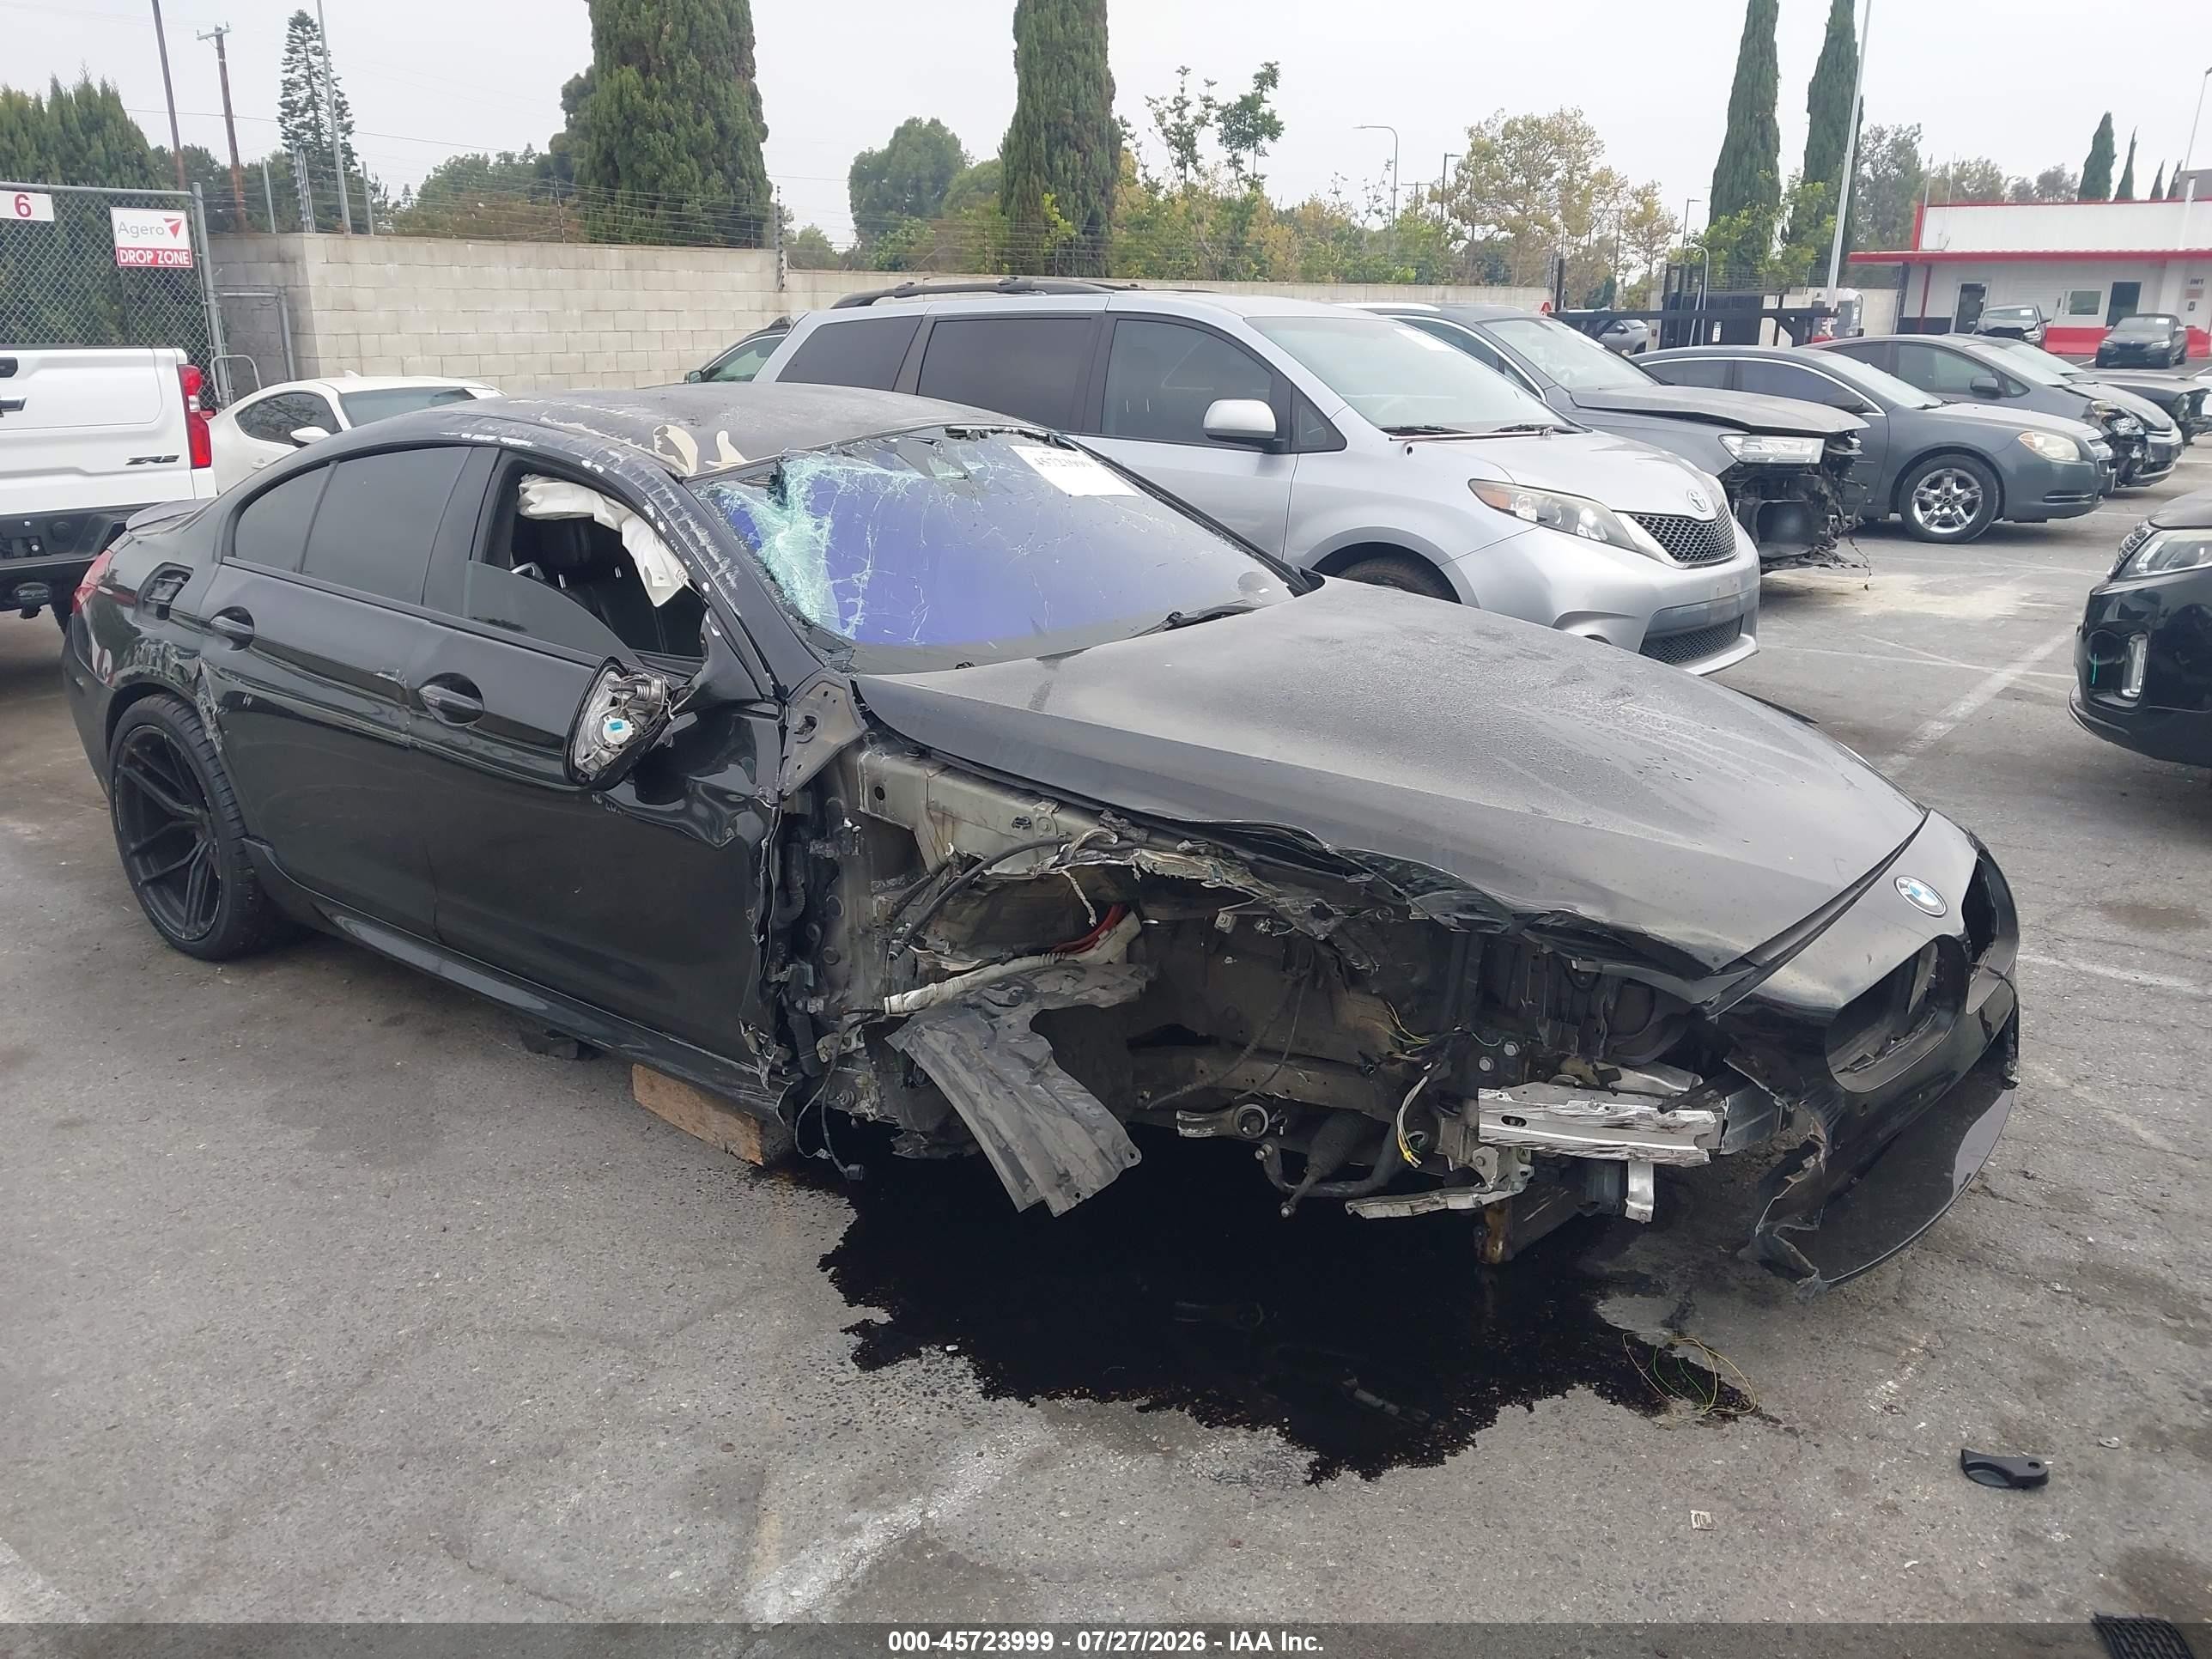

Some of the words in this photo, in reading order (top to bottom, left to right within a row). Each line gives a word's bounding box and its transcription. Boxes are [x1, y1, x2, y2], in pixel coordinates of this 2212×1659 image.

[14, 193, 32, 217] 6
[118, 221, 165, 238] Agero
[119, 249, 153, 264] DROP
[156, 250, 189, 265] ZONE
[125, 454, 180, 465] ZR2
